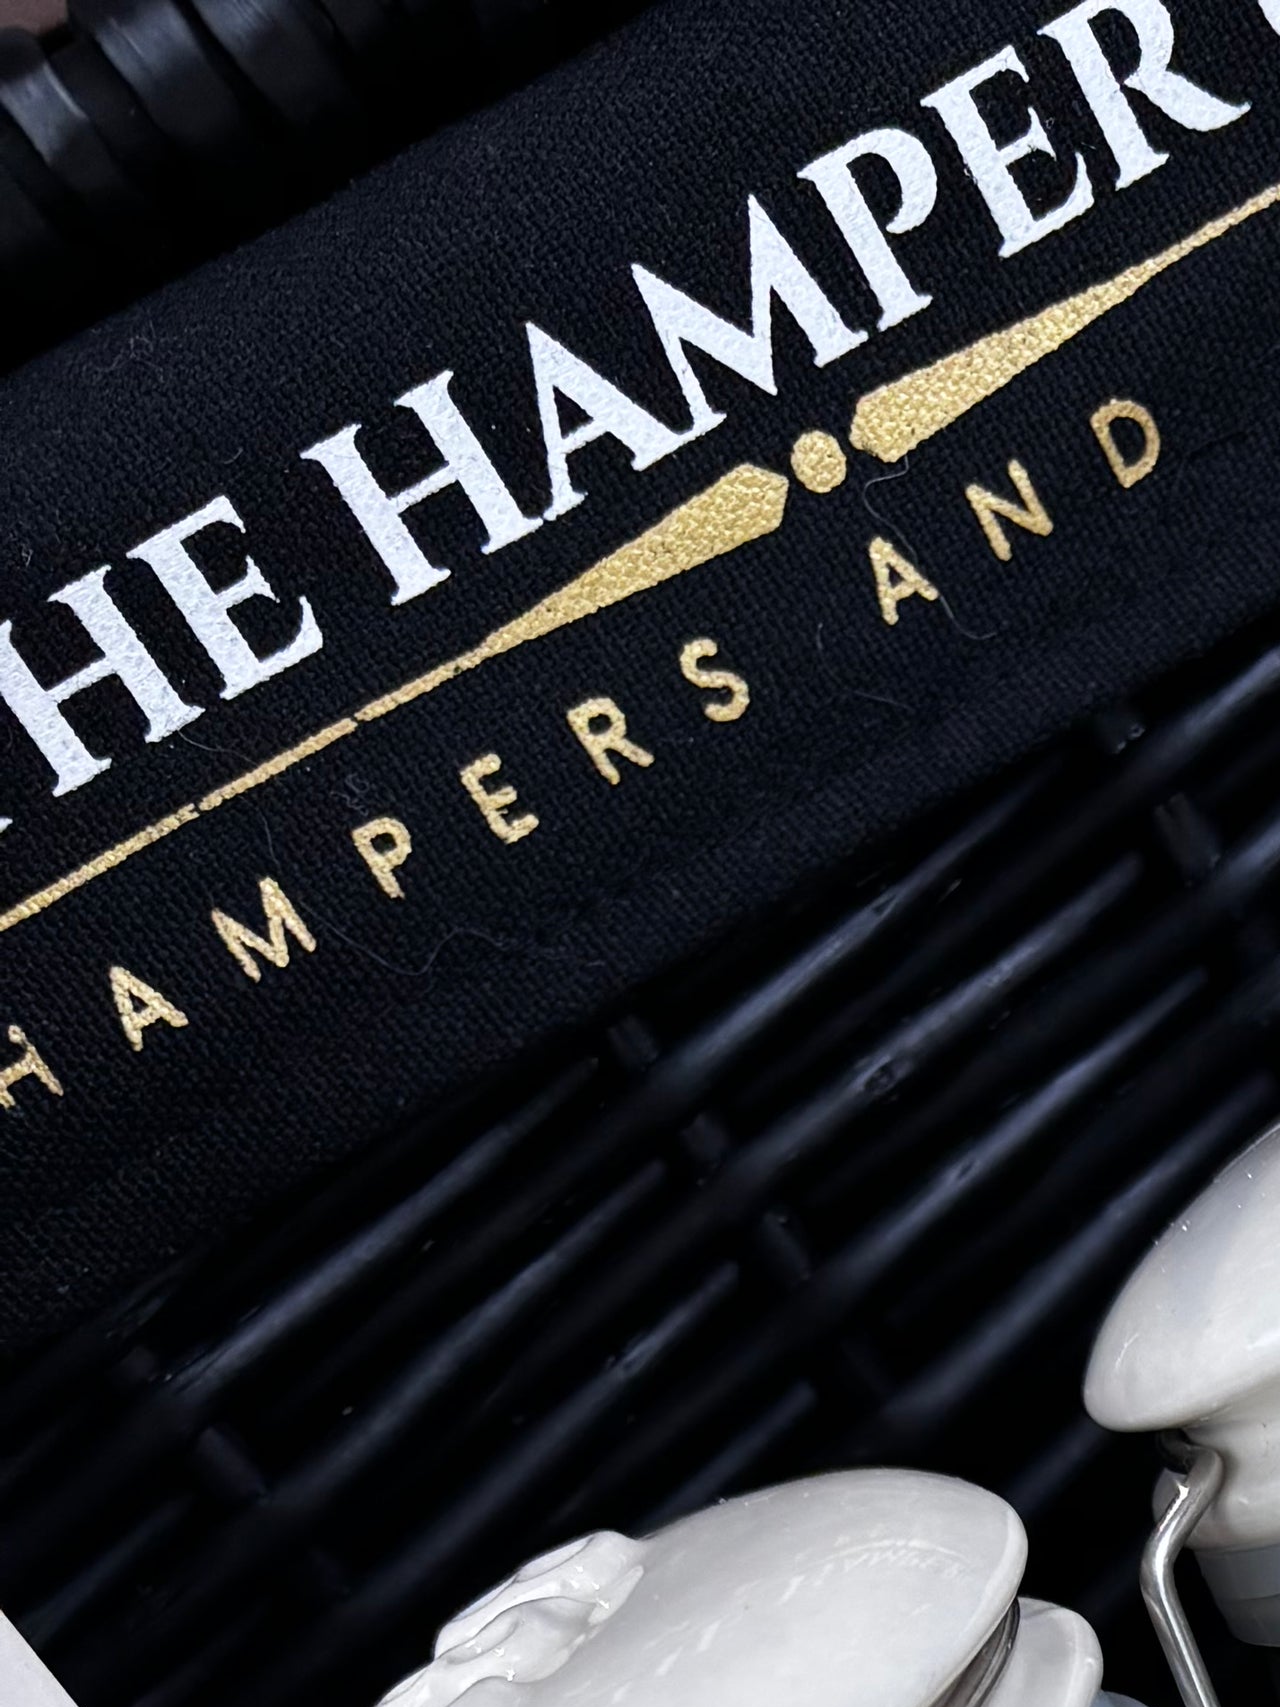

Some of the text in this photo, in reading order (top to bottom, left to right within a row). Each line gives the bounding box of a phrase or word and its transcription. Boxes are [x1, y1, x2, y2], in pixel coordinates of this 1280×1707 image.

[0, 0, 1251, 800] HE HAMPER
[868, 398, 1161, 626] AND
